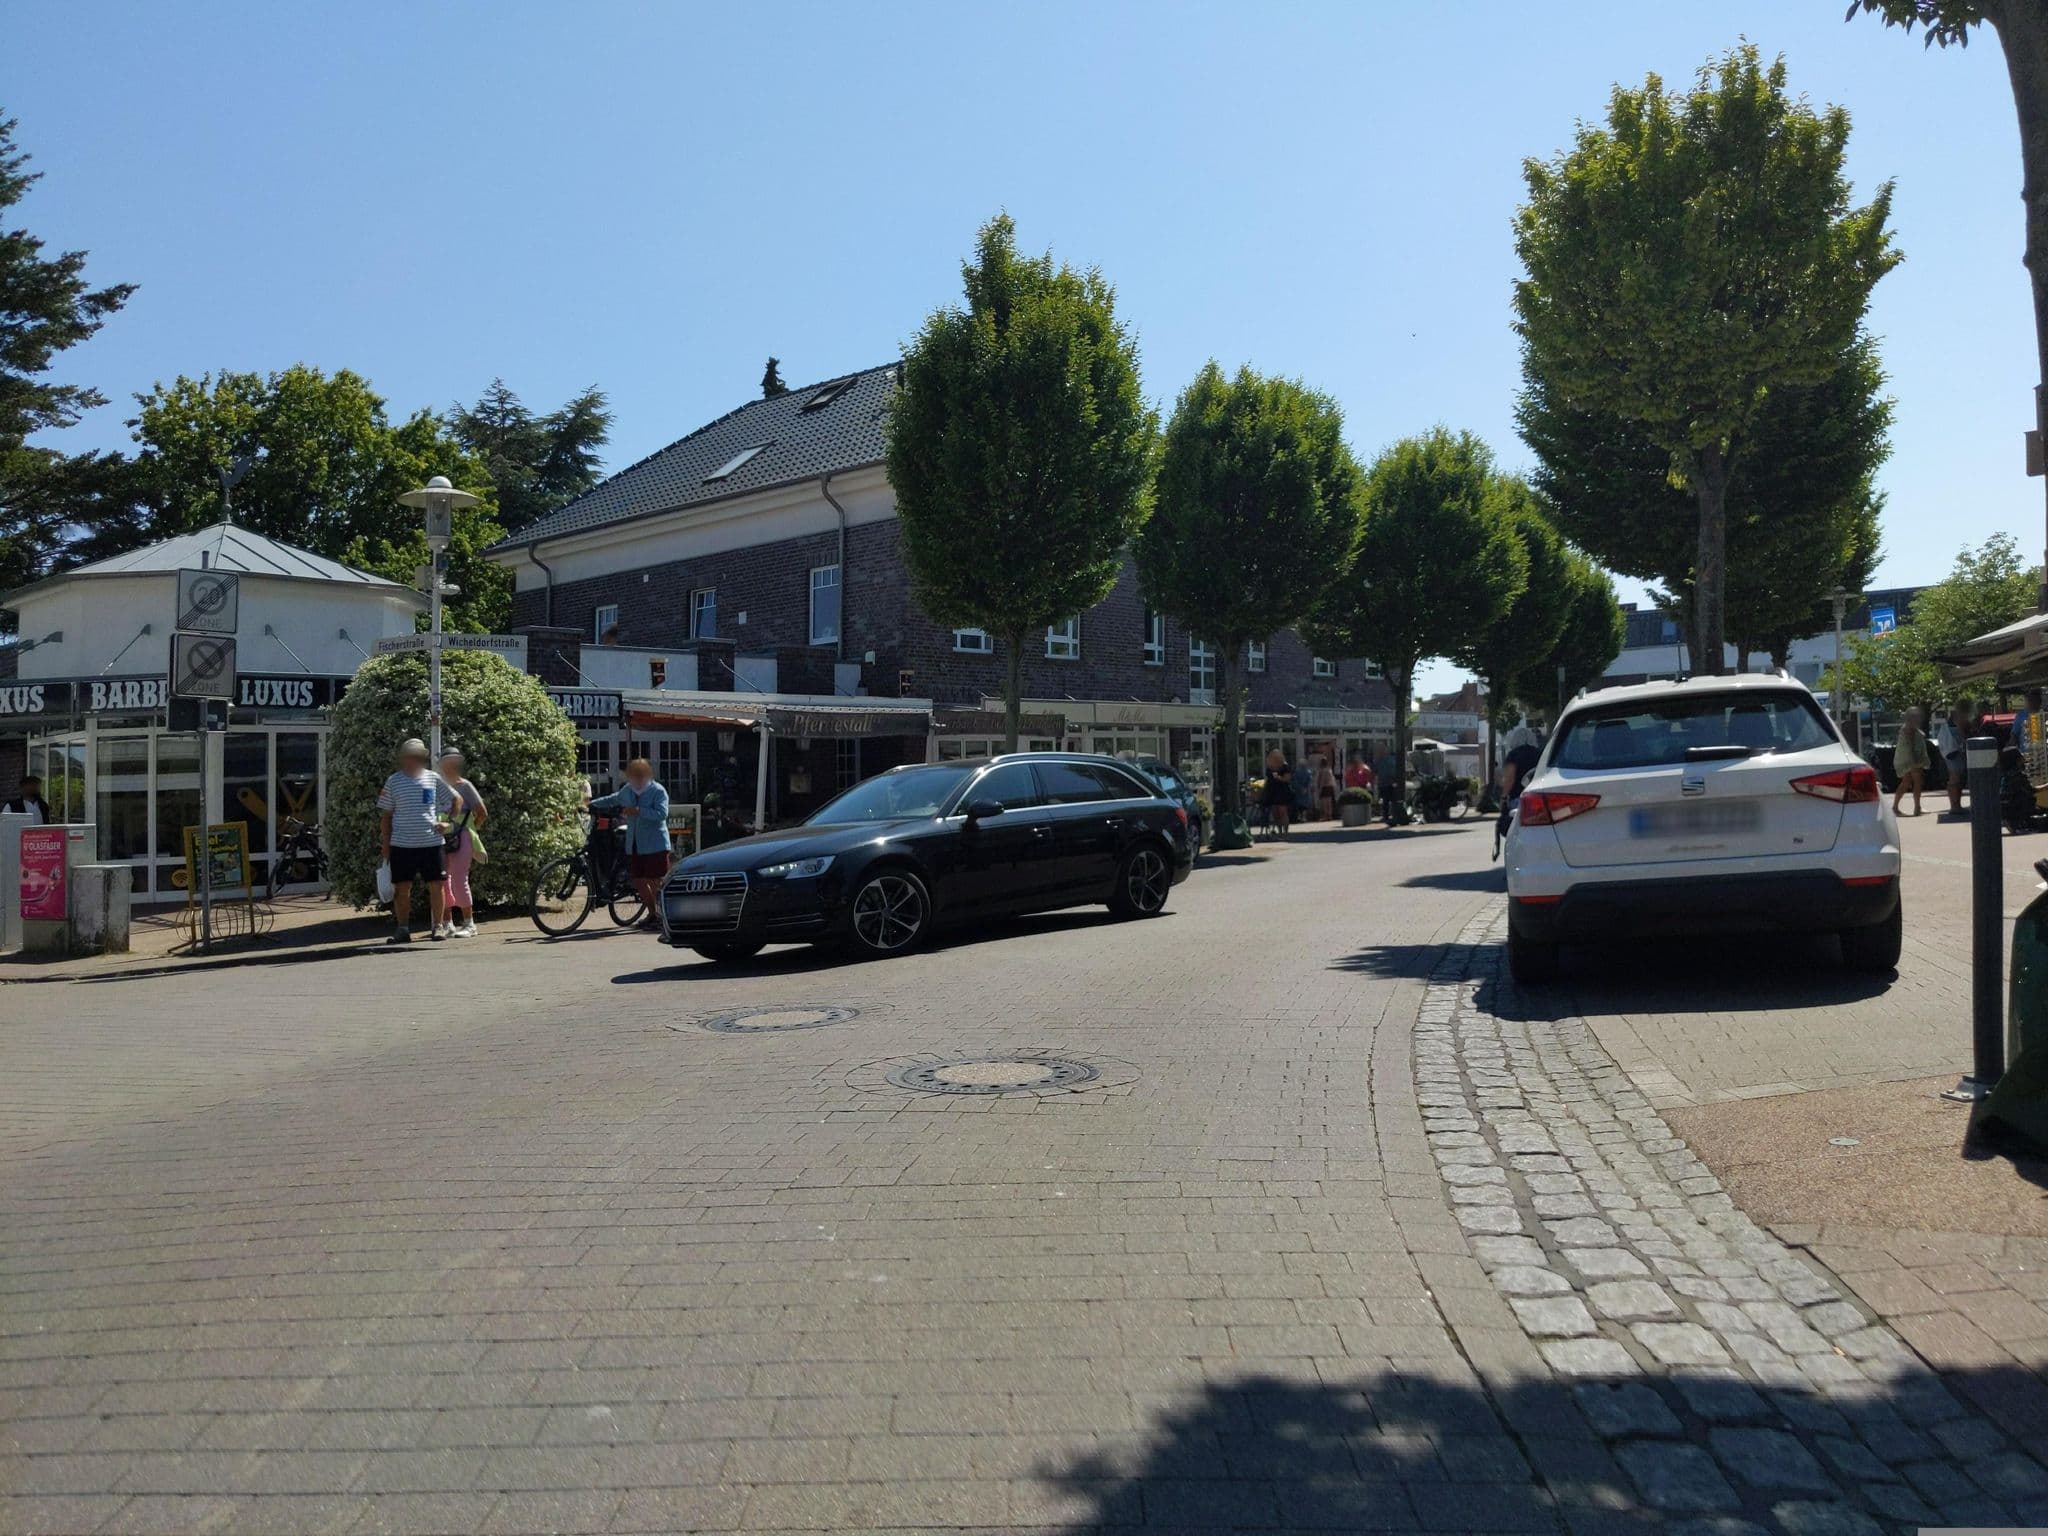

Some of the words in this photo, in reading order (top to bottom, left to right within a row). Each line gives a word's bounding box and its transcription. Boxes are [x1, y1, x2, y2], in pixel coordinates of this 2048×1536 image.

[193, 616, 223, 628] ZONE
[378, 639, 425, 650] Fischerstraße
[448, 636, 521, 648] Wicheldorfstraße
[191, 681, 222, 694] ZONE
[90, 680, 168, 710] BARBI
[241, 679, 314, 707] LUXUS
